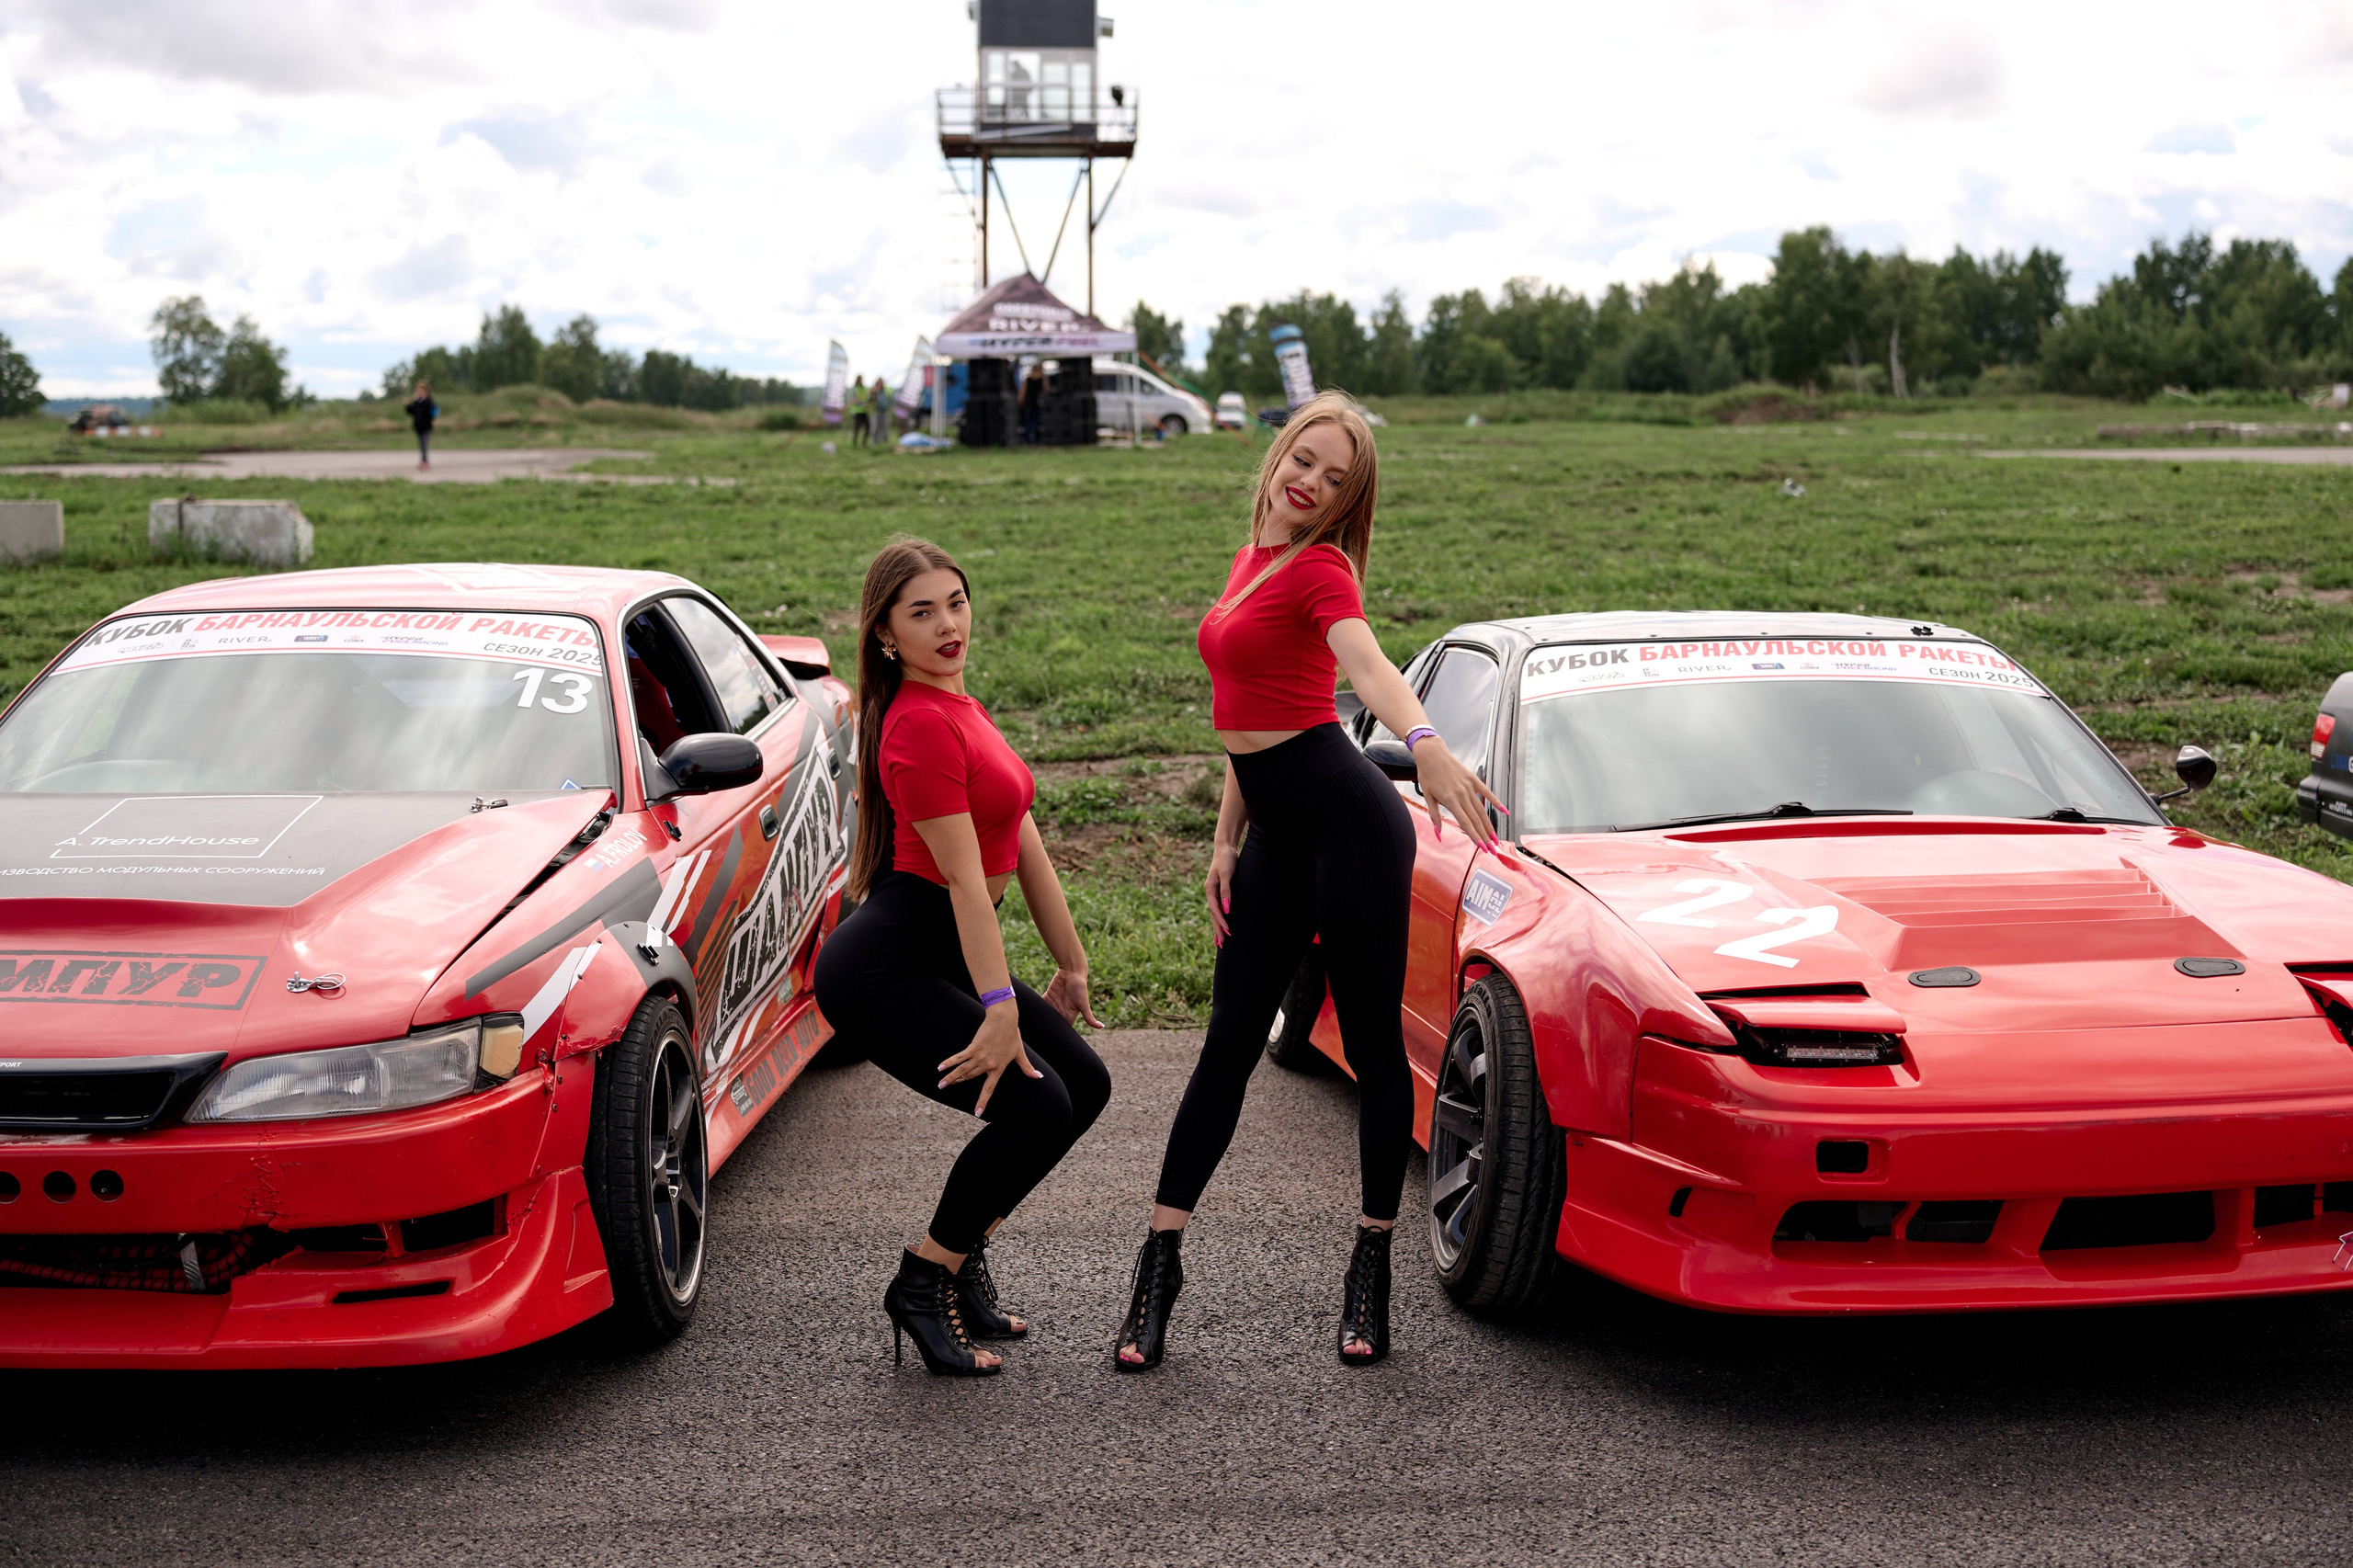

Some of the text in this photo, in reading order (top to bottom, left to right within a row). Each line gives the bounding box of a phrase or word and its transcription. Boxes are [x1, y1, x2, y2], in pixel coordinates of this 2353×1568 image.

[85, 618, 194, 647] КУБОК
[194, 612, 463, 631] БАРНАУЛЬСКОЙ
[218, 636, 272, 644] RIVER
[483, 642, 602, 666] СЕЗОН 2025
[1527, 640, 2017, 677] КУБОК БАРНАУЛЬСКОЙ РАКЕТЫ
[1678, 665, 1732, 673] RIVER
[1928, 667, 2034, 687] СЕЗОН 2025
[513, 667, 593, 714] 13
[90, 835, 260, 846] TrendHouse
[596, 827, 648, 868] A.FROLOV
[96, 866, 203, 874] МОДУЛЬНЫХ
[205, 866, 326, 876] СООРУЖЕНИЙ
[1635, 879, 1839, 969] 22
[745, 1059, 777, 1106] GOOD
[770, 1033, 799, 1078] DEED
[794, 1009, 820, 1053] AUTO
